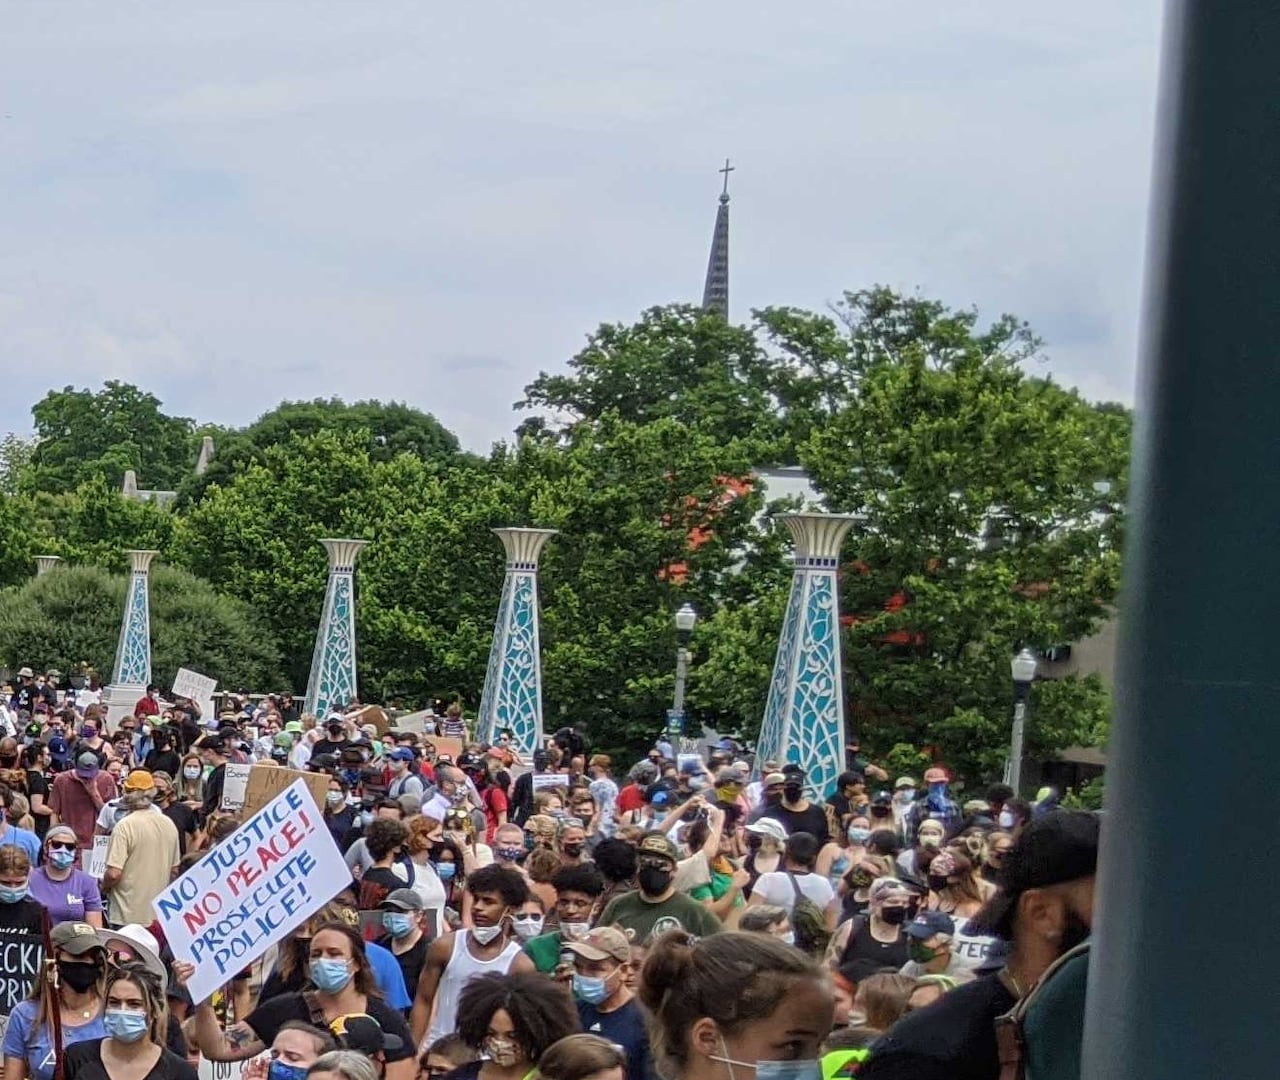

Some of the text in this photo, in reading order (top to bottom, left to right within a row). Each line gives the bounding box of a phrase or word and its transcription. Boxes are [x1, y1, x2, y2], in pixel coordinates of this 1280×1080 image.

[157, 788, 305, 921] NO JUSTICE
[181, 810, 316, 936] NO PEACE!
[189, 850, 317, 965] PROSECUTE
[213, 881, 312, 975] POLICE!
